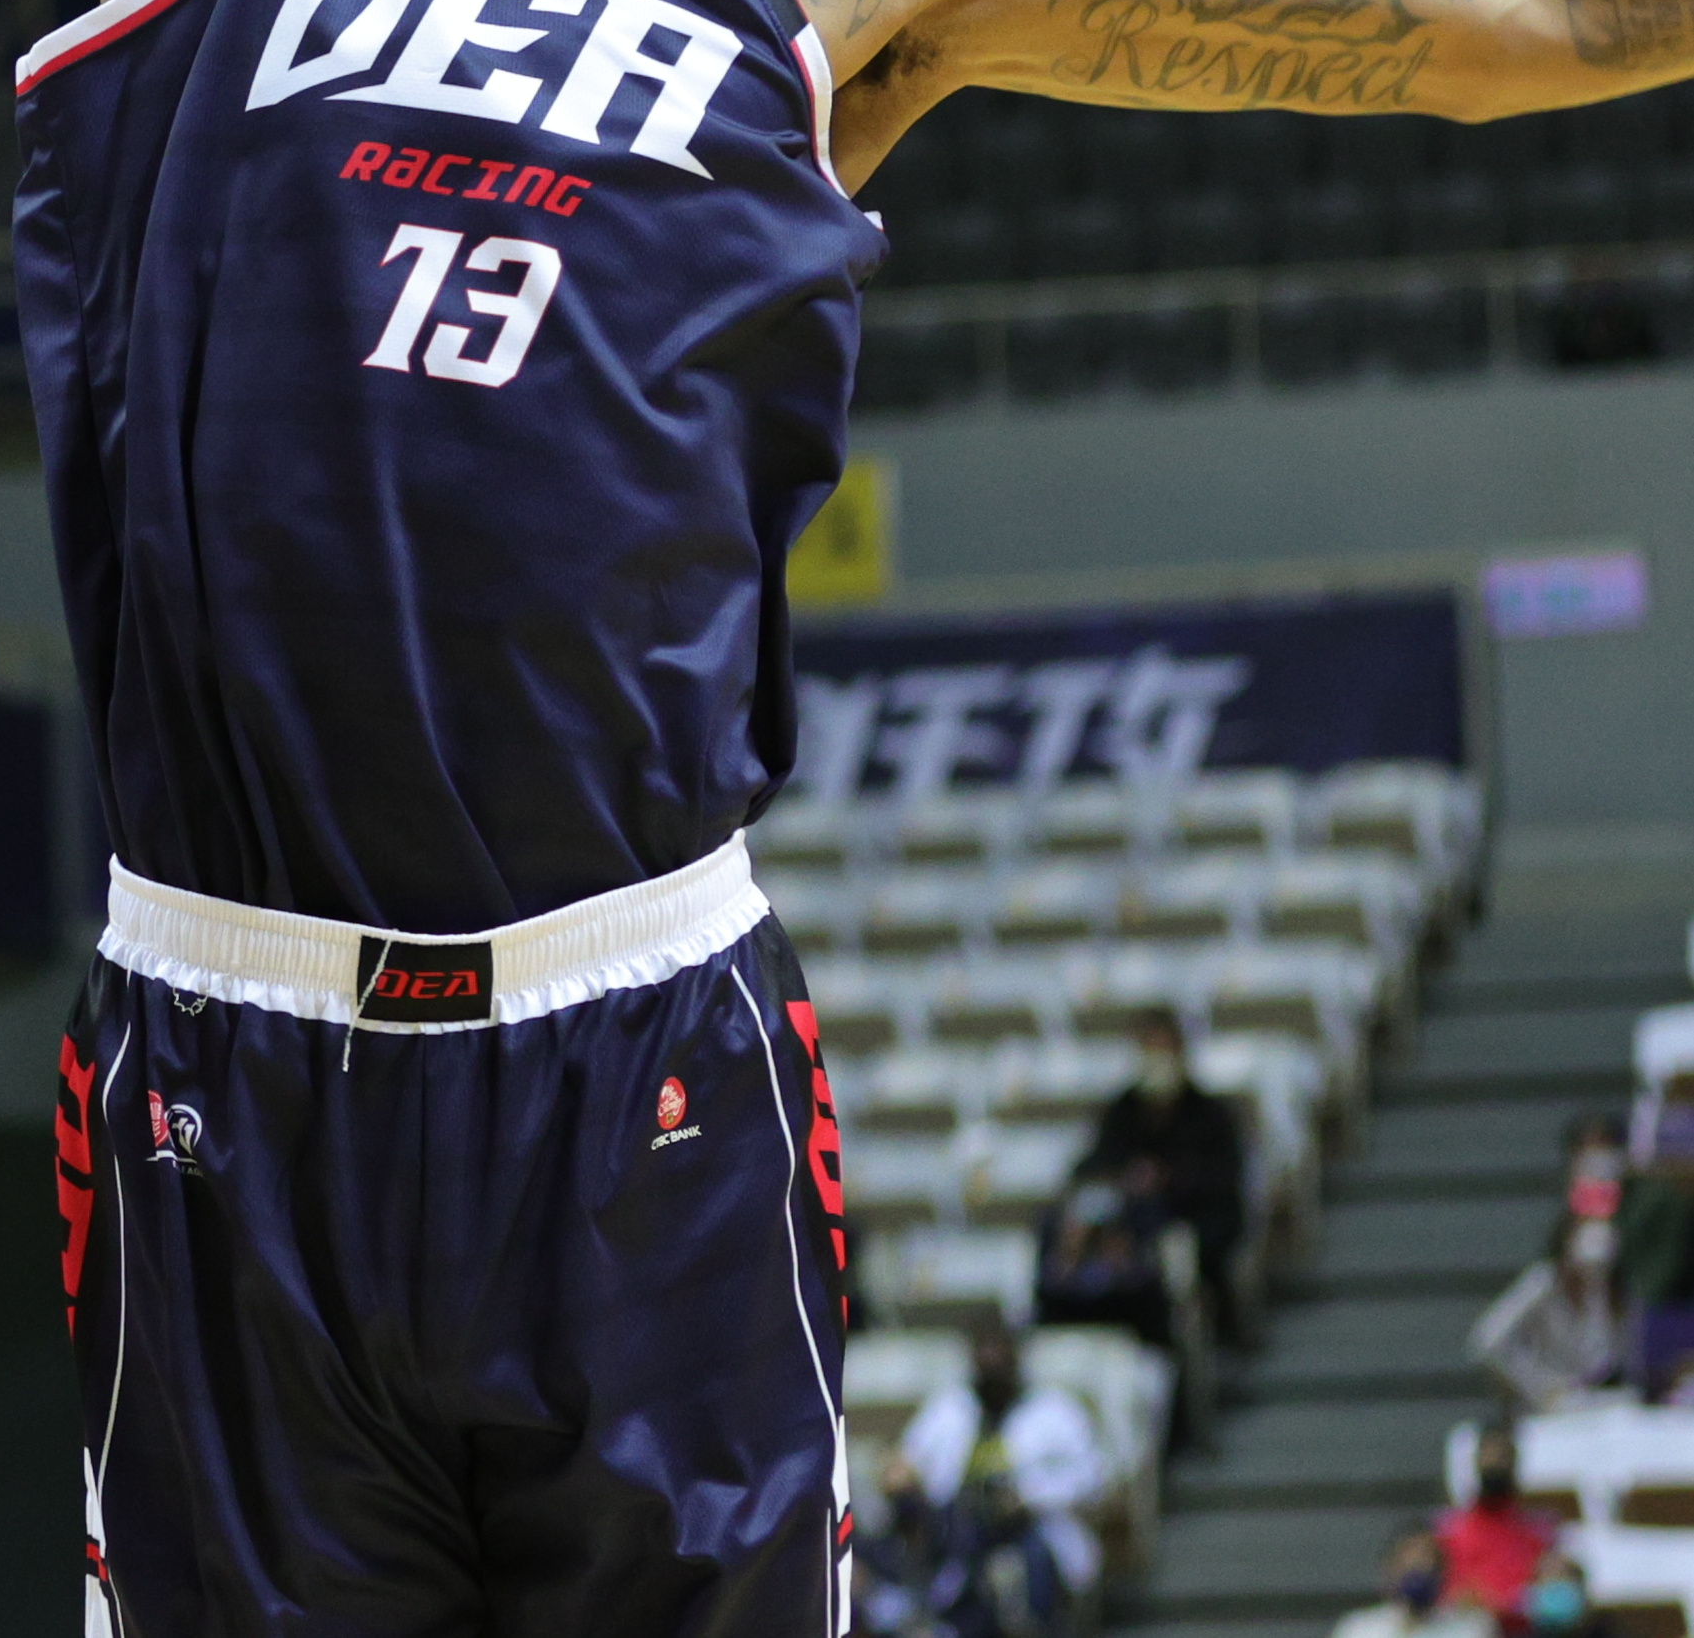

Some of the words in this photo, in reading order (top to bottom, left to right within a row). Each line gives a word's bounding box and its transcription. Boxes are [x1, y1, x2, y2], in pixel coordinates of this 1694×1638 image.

[362, 222, 563, 388] 13
[374, 969, 480, 1000] DEA
[670, 1124, 703, 1143] BANK
